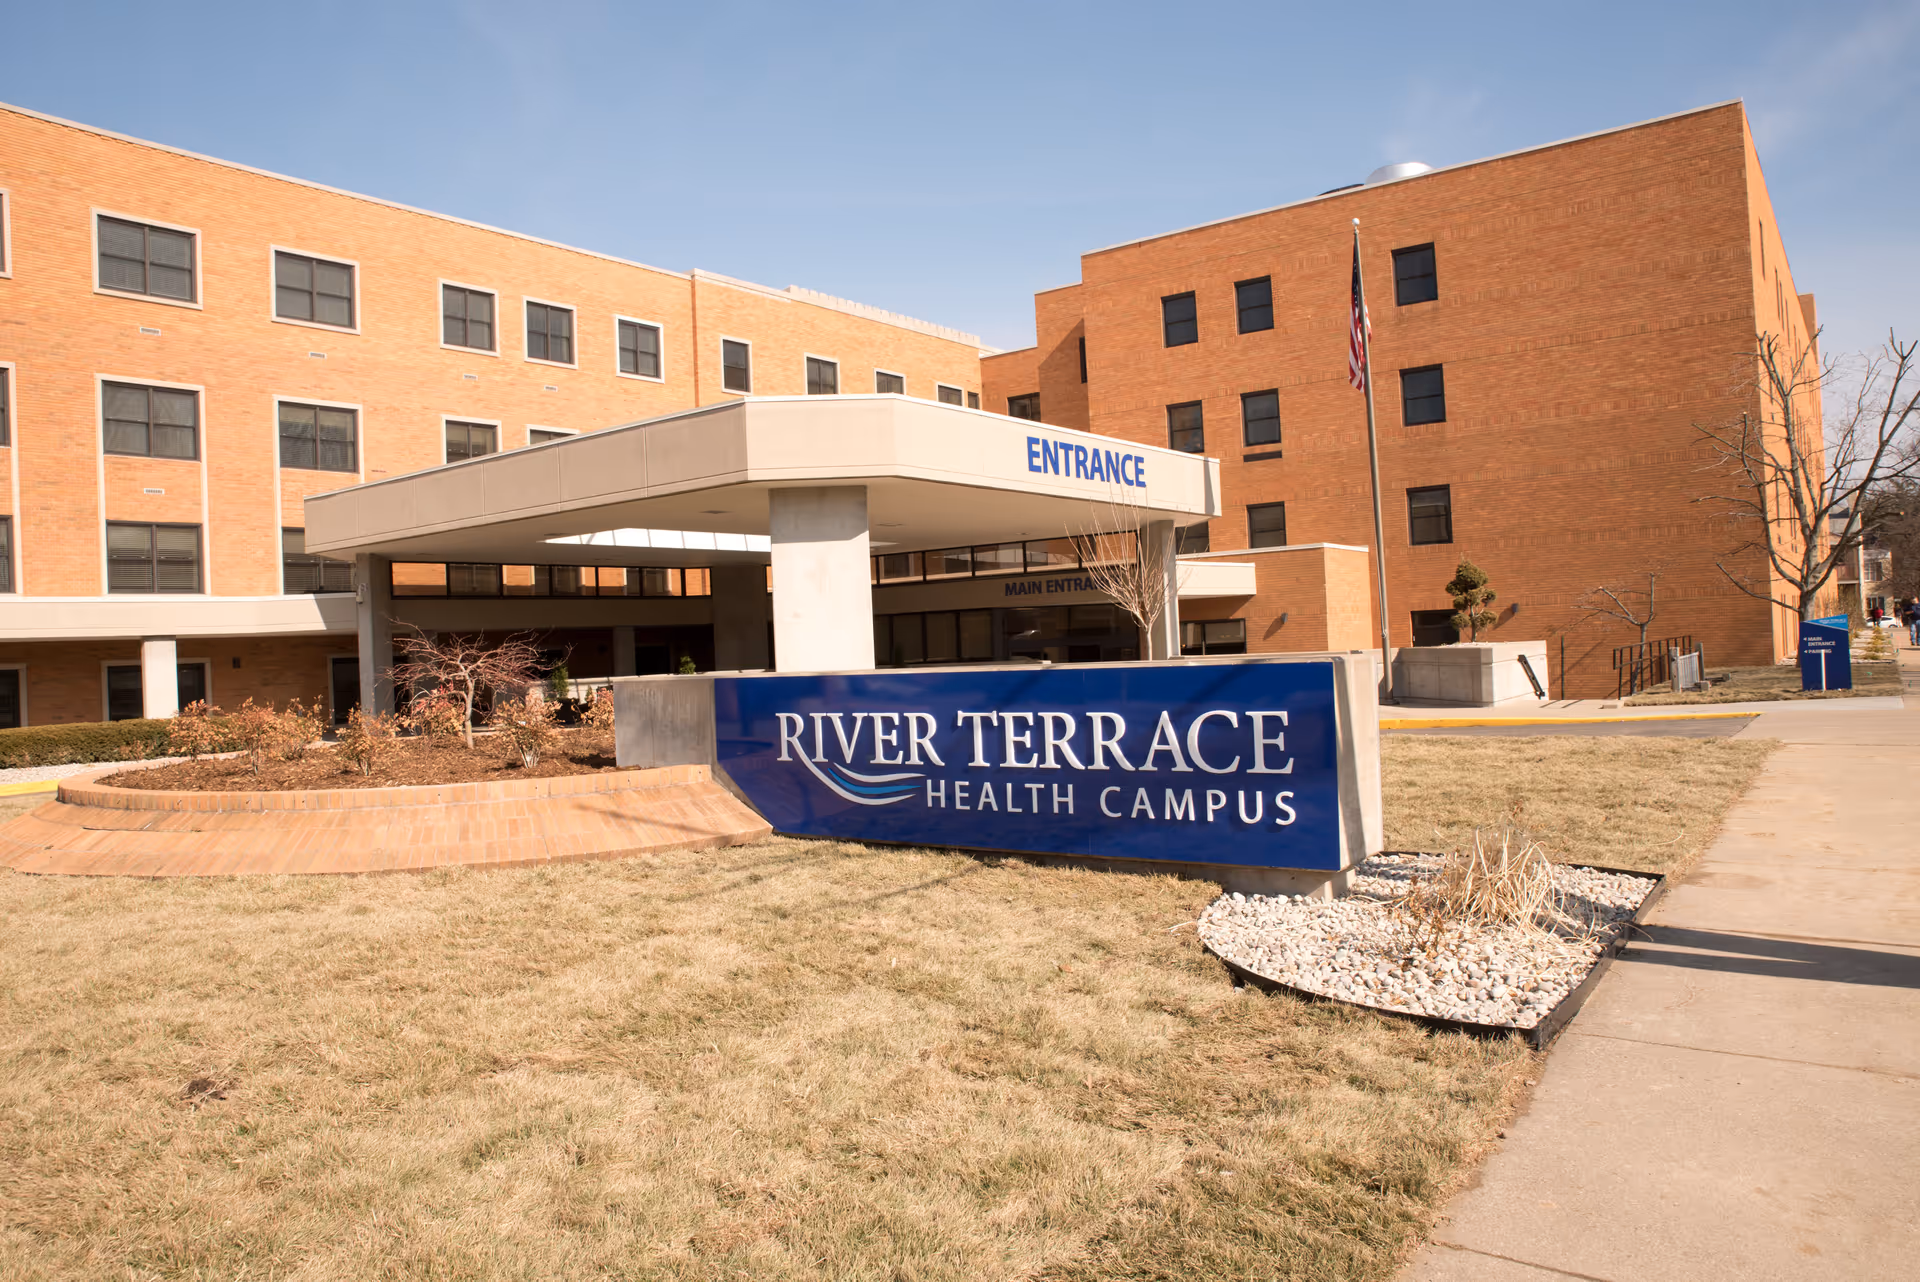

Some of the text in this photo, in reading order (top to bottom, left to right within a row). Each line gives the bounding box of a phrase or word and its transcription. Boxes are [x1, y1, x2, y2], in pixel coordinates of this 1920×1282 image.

[1027, 436, 1147, 488] ENTRANCE
[1005, 573, 1121, 596] MAIN ENTRA
[775, 710, 1294, 774] RIVER TERRACE
[926, 779, 1297, 826] HEALTH CAMPUS
